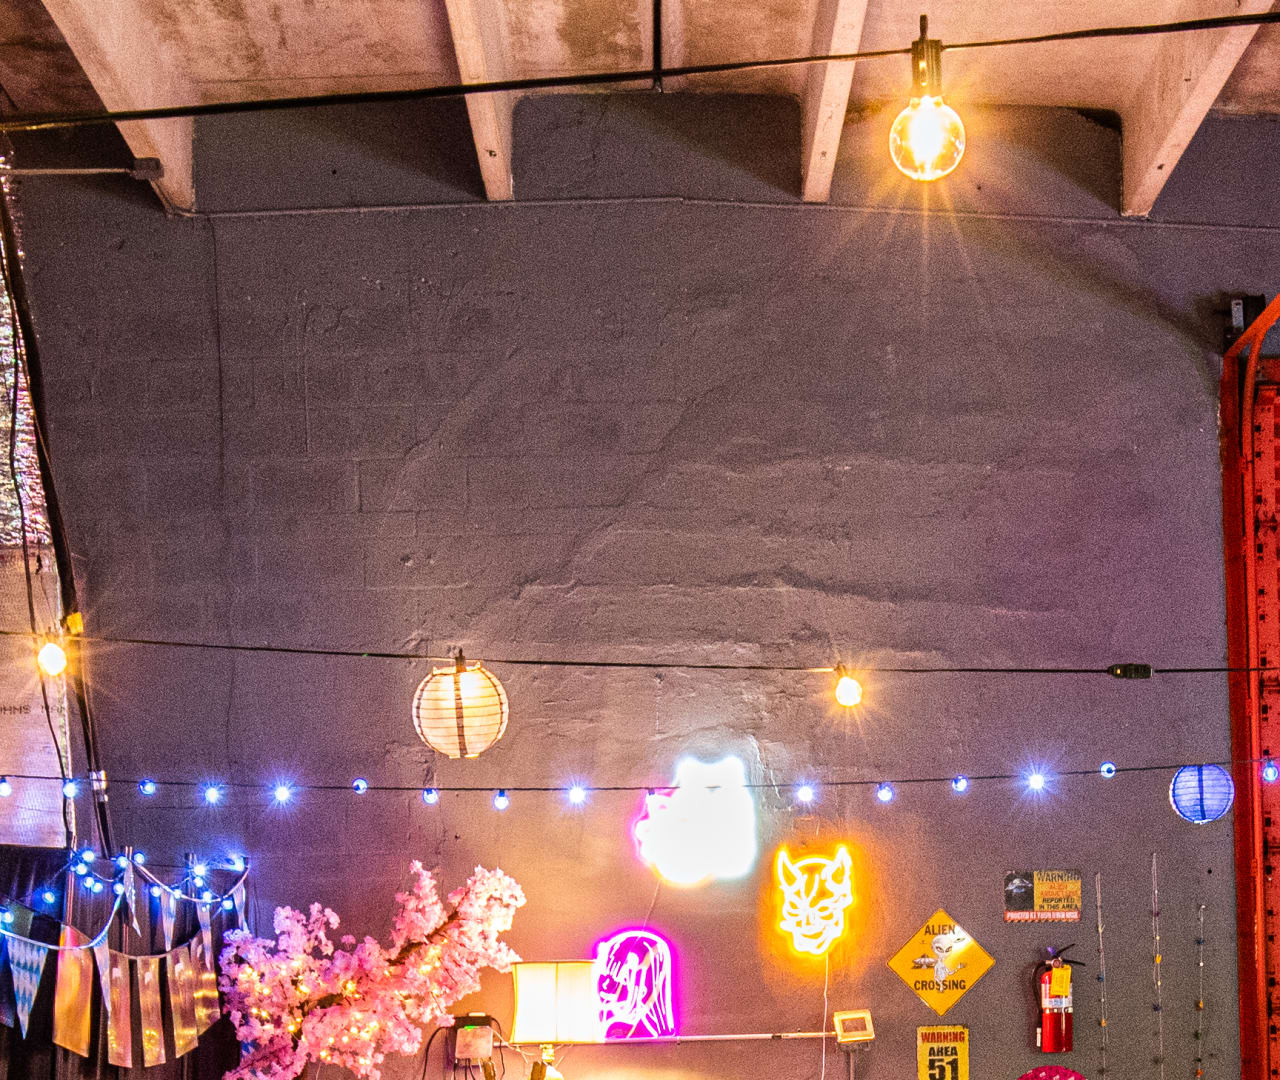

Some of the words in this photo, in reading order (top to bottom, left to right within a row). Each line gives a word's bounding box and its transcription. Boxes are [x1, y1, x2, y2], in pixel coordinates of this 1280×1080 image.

[924, 924, 956, 936] ALIEN
[913, 979, 966, 991] CROSSING
[921, 1031, 965, 1043] WARNING
[928, 1046, 958, 1057] AREA
